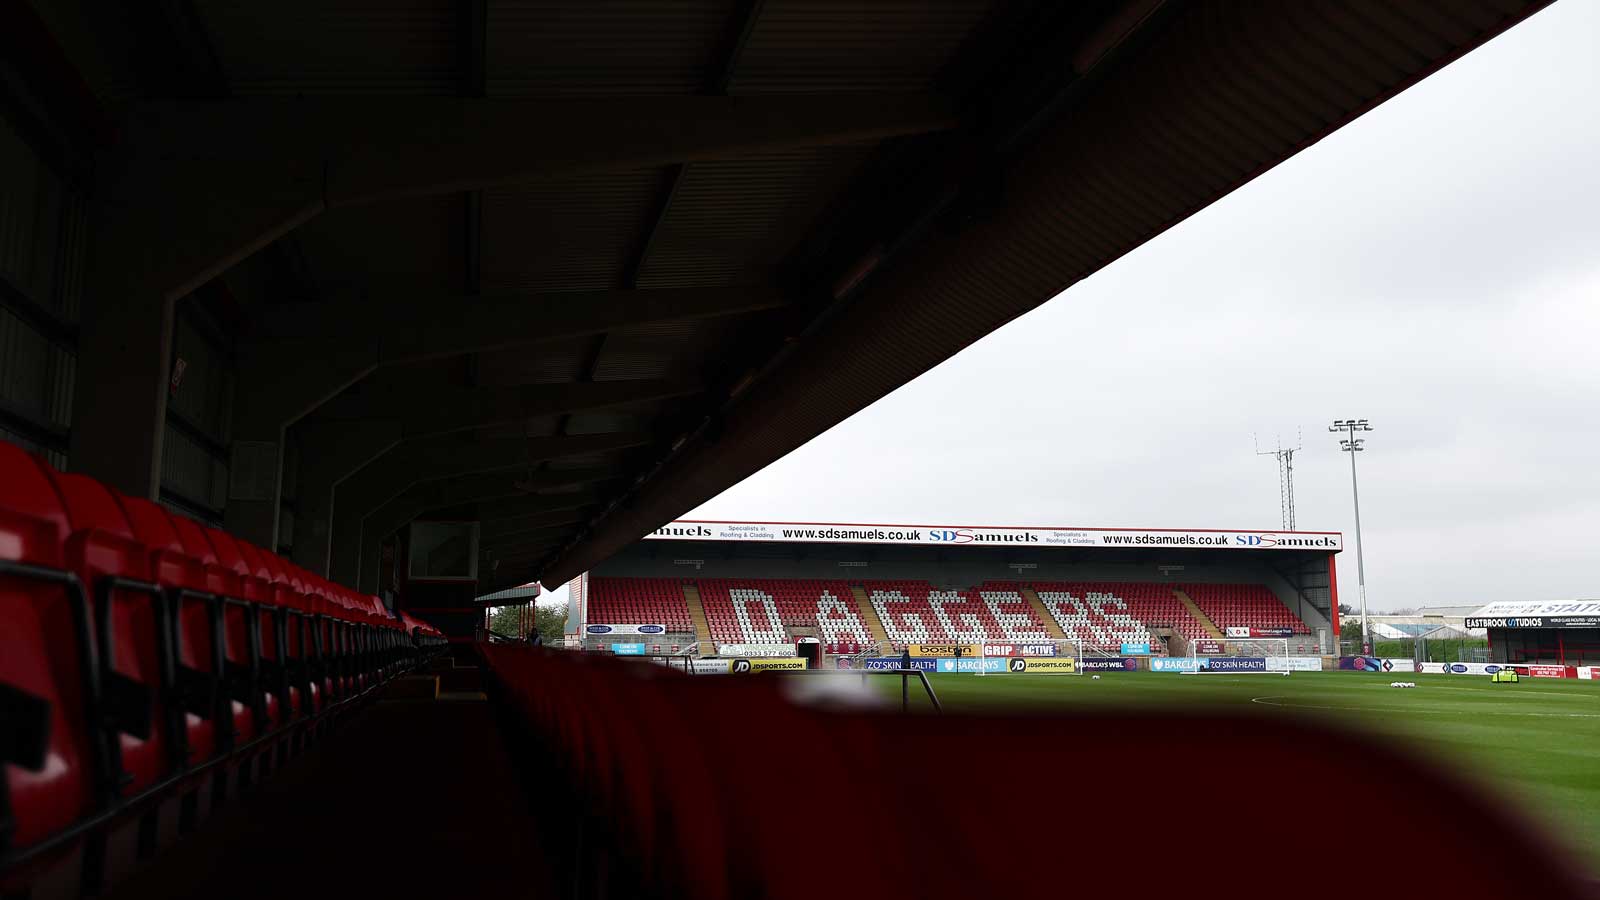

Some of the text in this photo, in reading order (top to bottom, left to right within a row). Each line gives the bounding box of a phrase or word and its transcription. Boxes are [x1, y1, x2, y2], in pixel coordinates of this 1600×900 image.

[720, 531, 742, 539] Roofing
[783, 528, 921, 541] www.sdsamuels.co.uk
[1103, 533, 1229, 546] www.sdsamuels.co.uk
[1046, 537, 1066, 545] Roofing
[1466, 617, 1542, 628] EASTBROOK STUDIOS
[984, 645, 1054, 656] GRIP ACTIVE
[734, 661, 749, 673] JD
[910, 661, 936, 669] EALTH
[1012, 659, 1025, 671] JD
[1165, 660, 1206, 670] BARCLAYS
[1238, 660, 1264, 669] HEALTH
